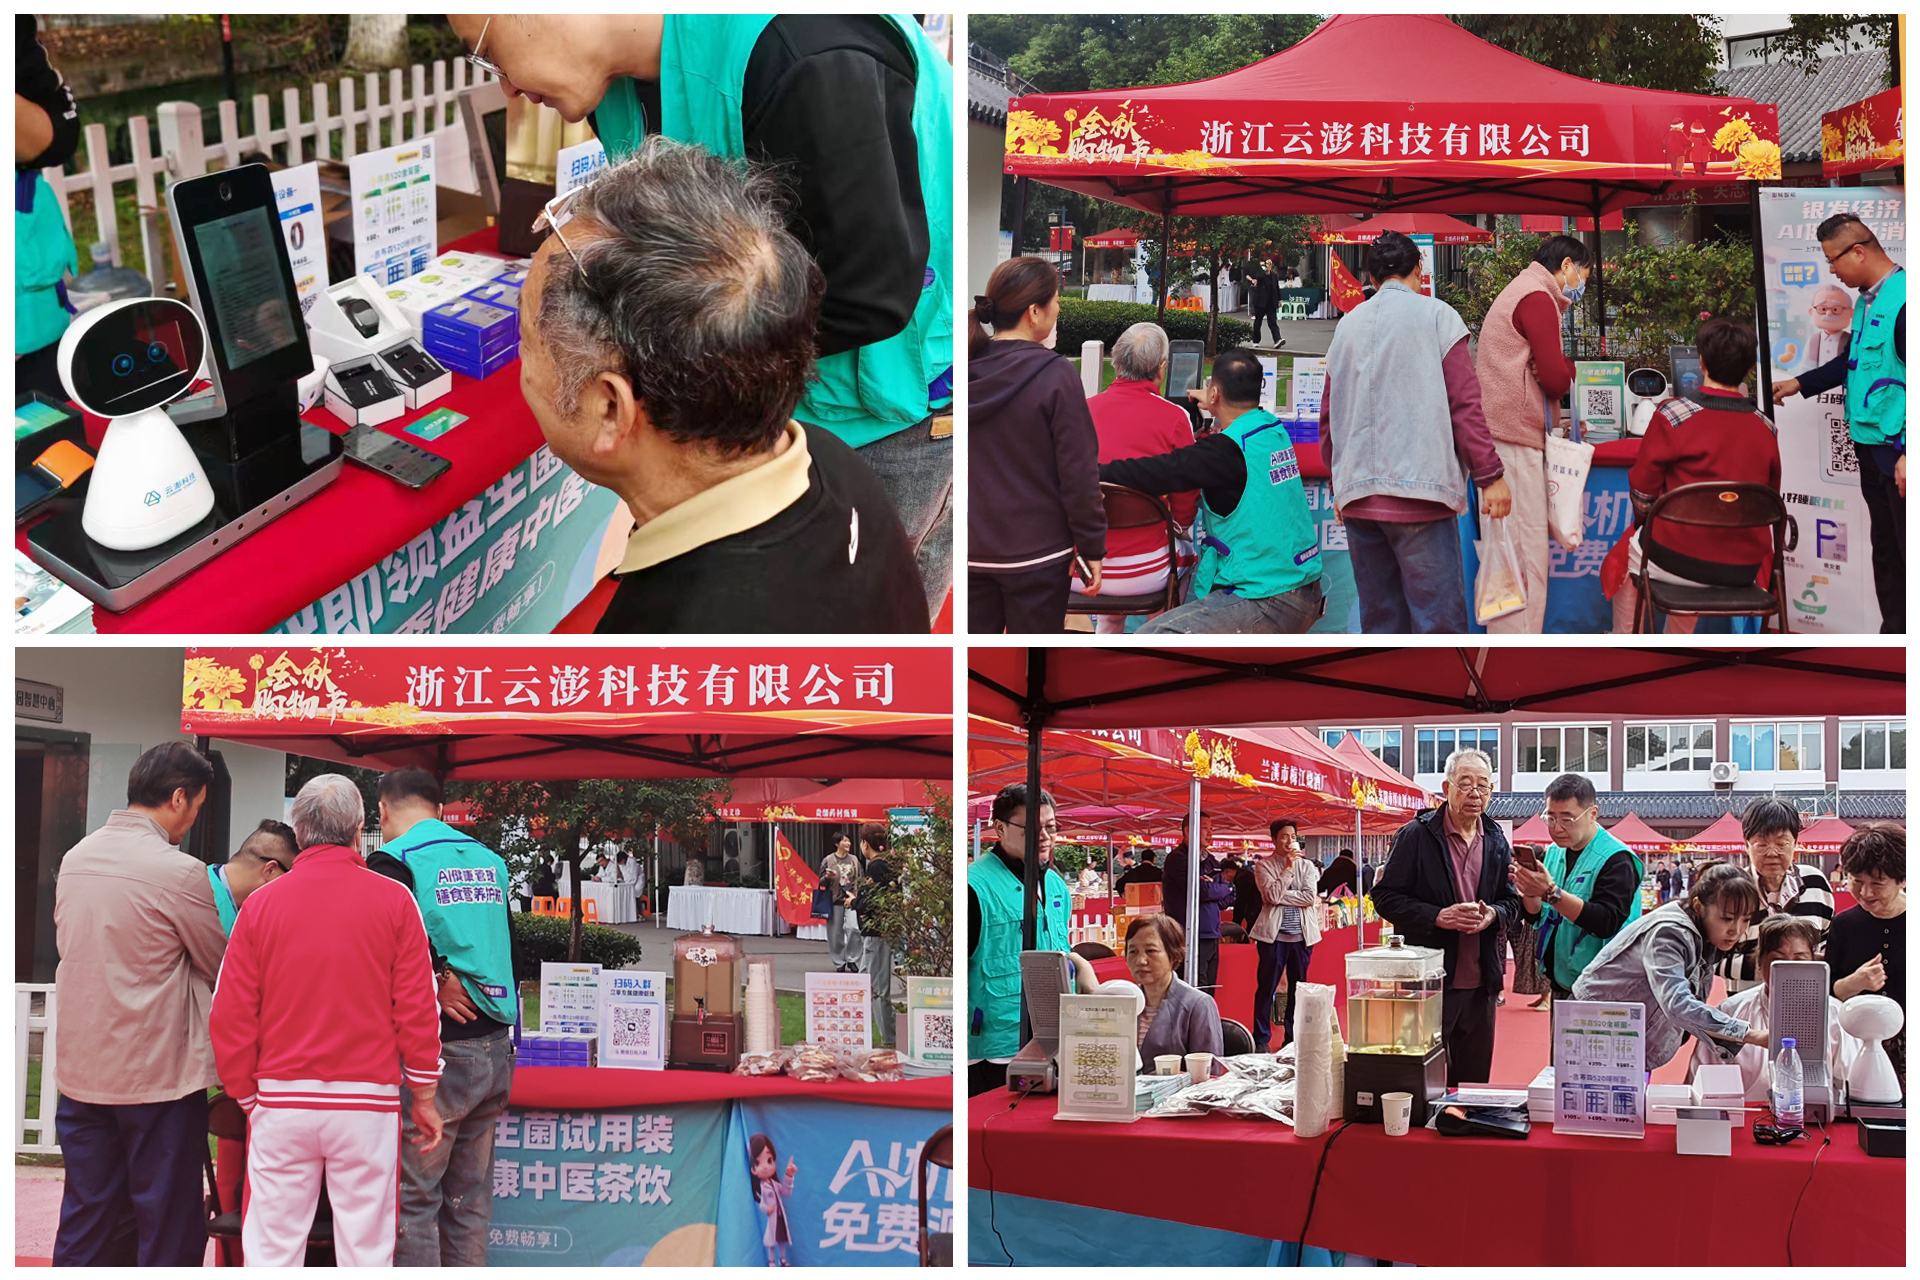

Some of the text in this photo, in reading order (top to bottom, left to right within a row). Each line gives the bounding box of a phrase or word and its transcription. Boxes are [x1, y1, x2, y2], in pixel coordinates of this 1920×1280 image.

[1078, 103, 1142, 140] 金秋
[1199, 120, 1591, 158] 浙江云澎科技有限公司
[1067, 136, 1152, 170] 购物节
[1801, 199, 1903, 220] 银发经济
[263, 648, 337, 691] 金秋
[404, 662, 896, 708] 浙江云澎科技有限公司
[251, 685, 350, 723] 购物节
[1260, 758, 1328, 792] 兰溪市梅江烧酒厂
[438, 868, 496, 884] AI健康管理
[435, 886, 503, 906] 膳食营养护航
[614, 978, 652, 989] 扫码入群
[495, 1110, 675, 1156] 生菌试用装
[493, 1160, 673, 1206] 康中医茶饮
[488, 1226, 559, 1249] 免费畅享!
